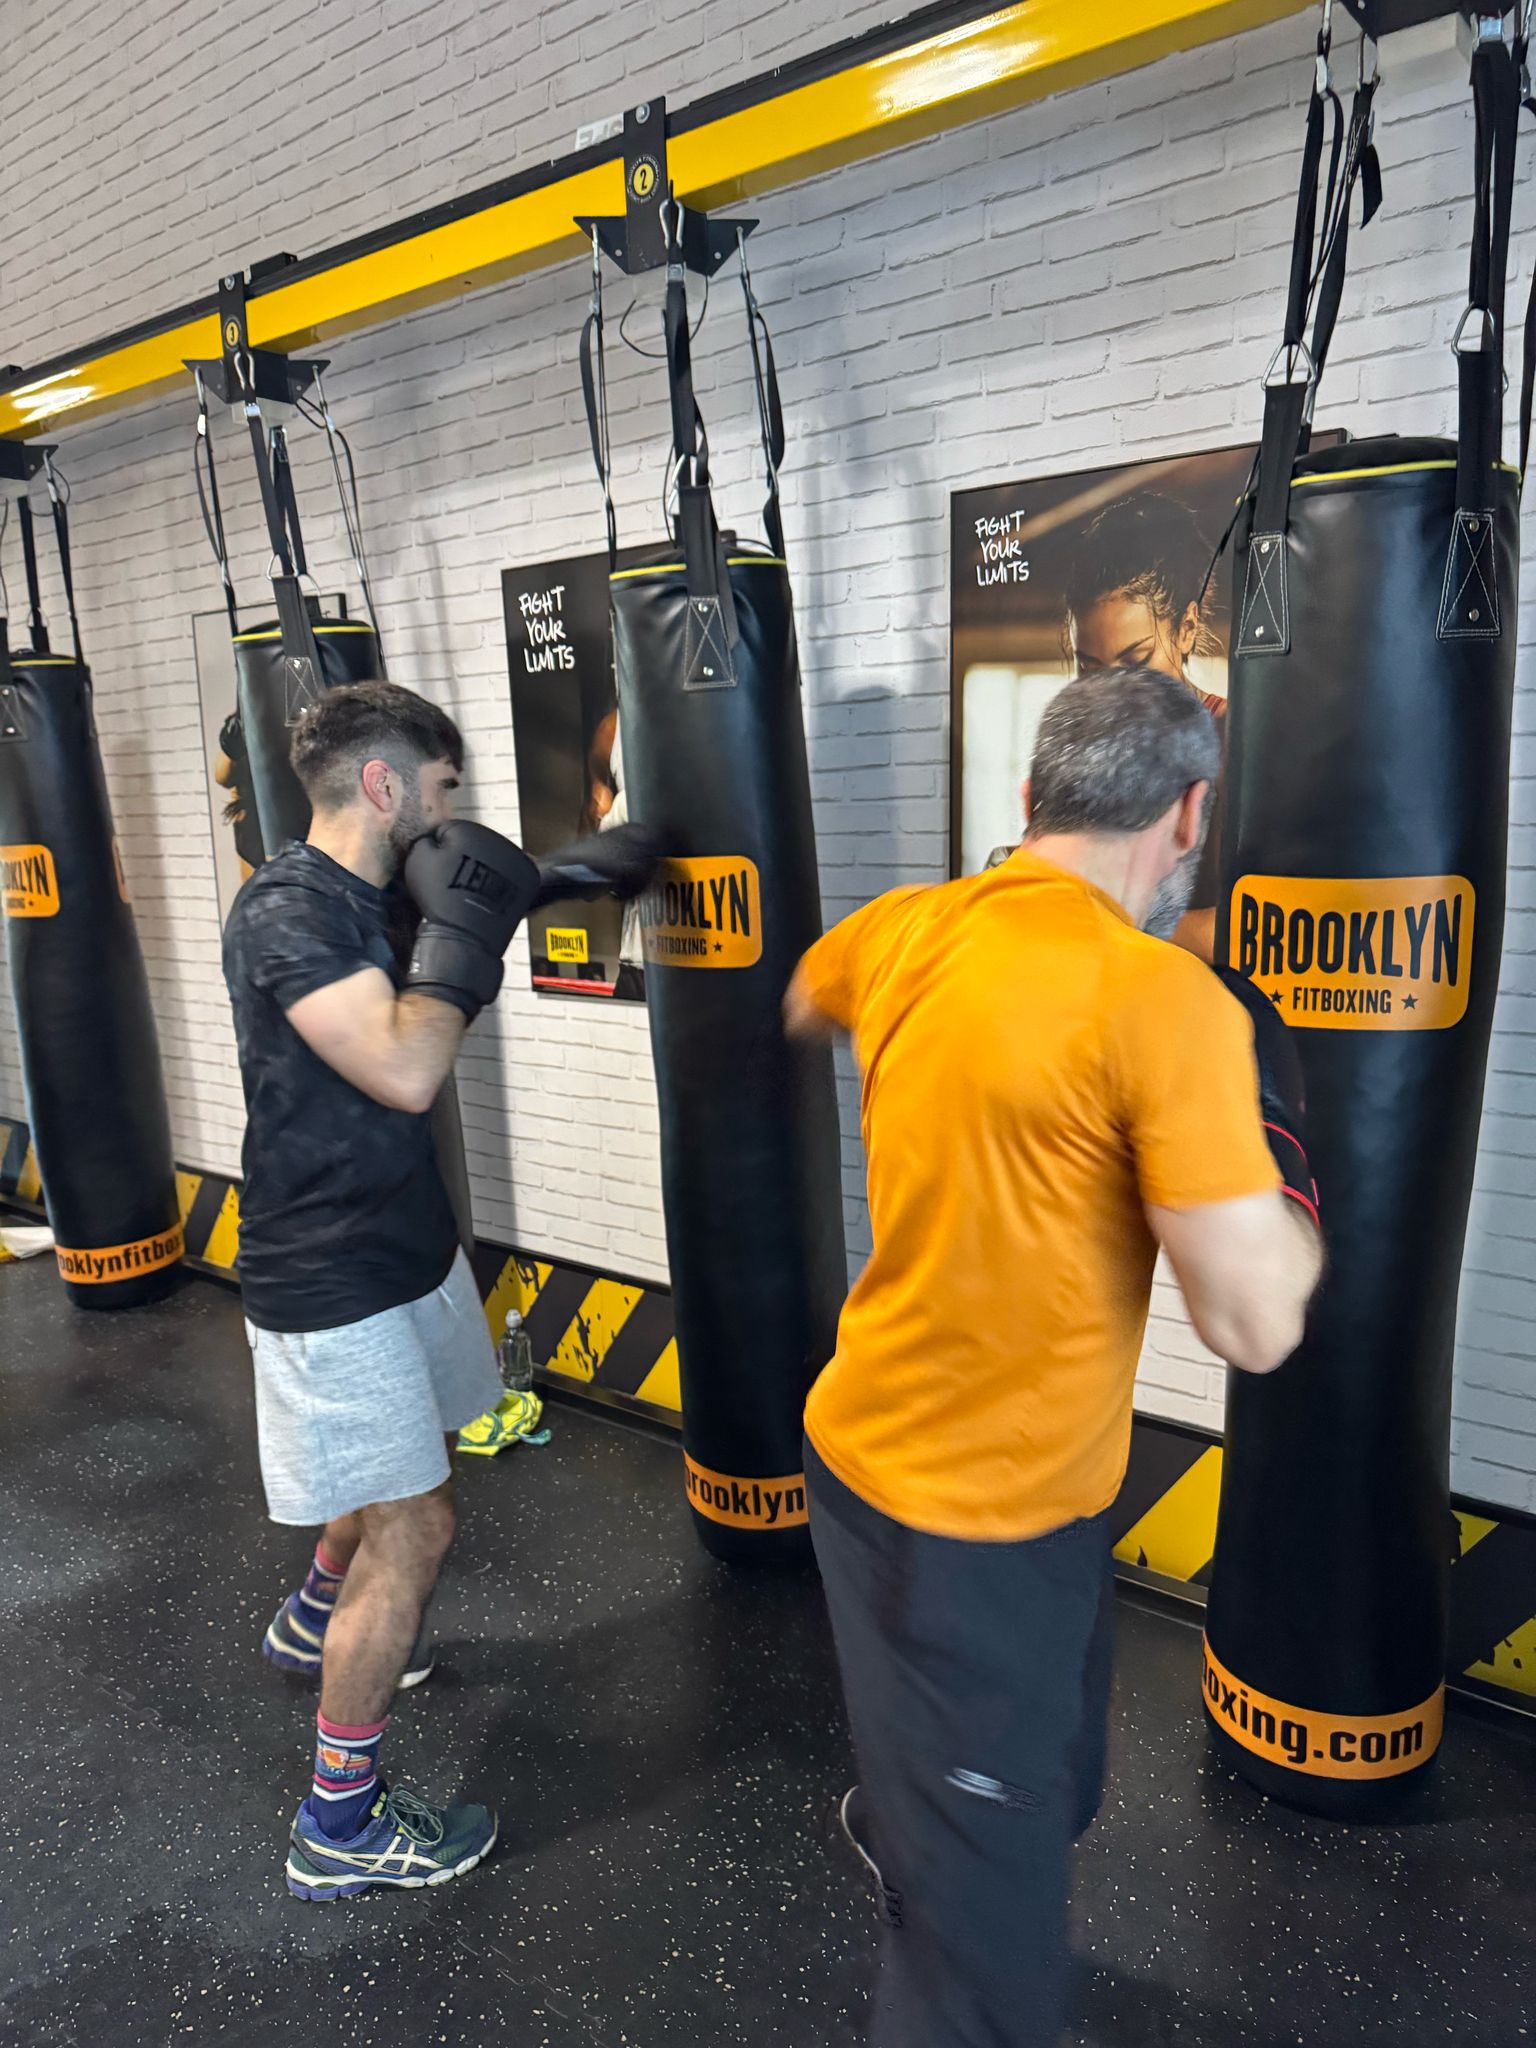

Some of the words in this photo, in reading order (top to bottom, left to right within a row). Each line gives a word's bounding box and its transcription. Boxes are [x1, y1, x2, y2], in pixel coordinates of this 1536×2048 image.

[640, 168, 648, 191] 2
[974, 509, 1025, 539] FIGHT
[980, 537, 1022, 564] YOUR
[976, 560, 1030, 587] LIMITS
[518, 585, 566, 618] FIGHT
[525, 616, 567, 647] YOUR
[523, 644, 576, 673] LIMITS
[550, 932, 585, 955] BROOKLYN
[656, 935, 708, 957] FITBOXING
[1239, 892, 1463, 987] BROOKLYN
[1292, 986, 1392, 1014] FITBOXING
